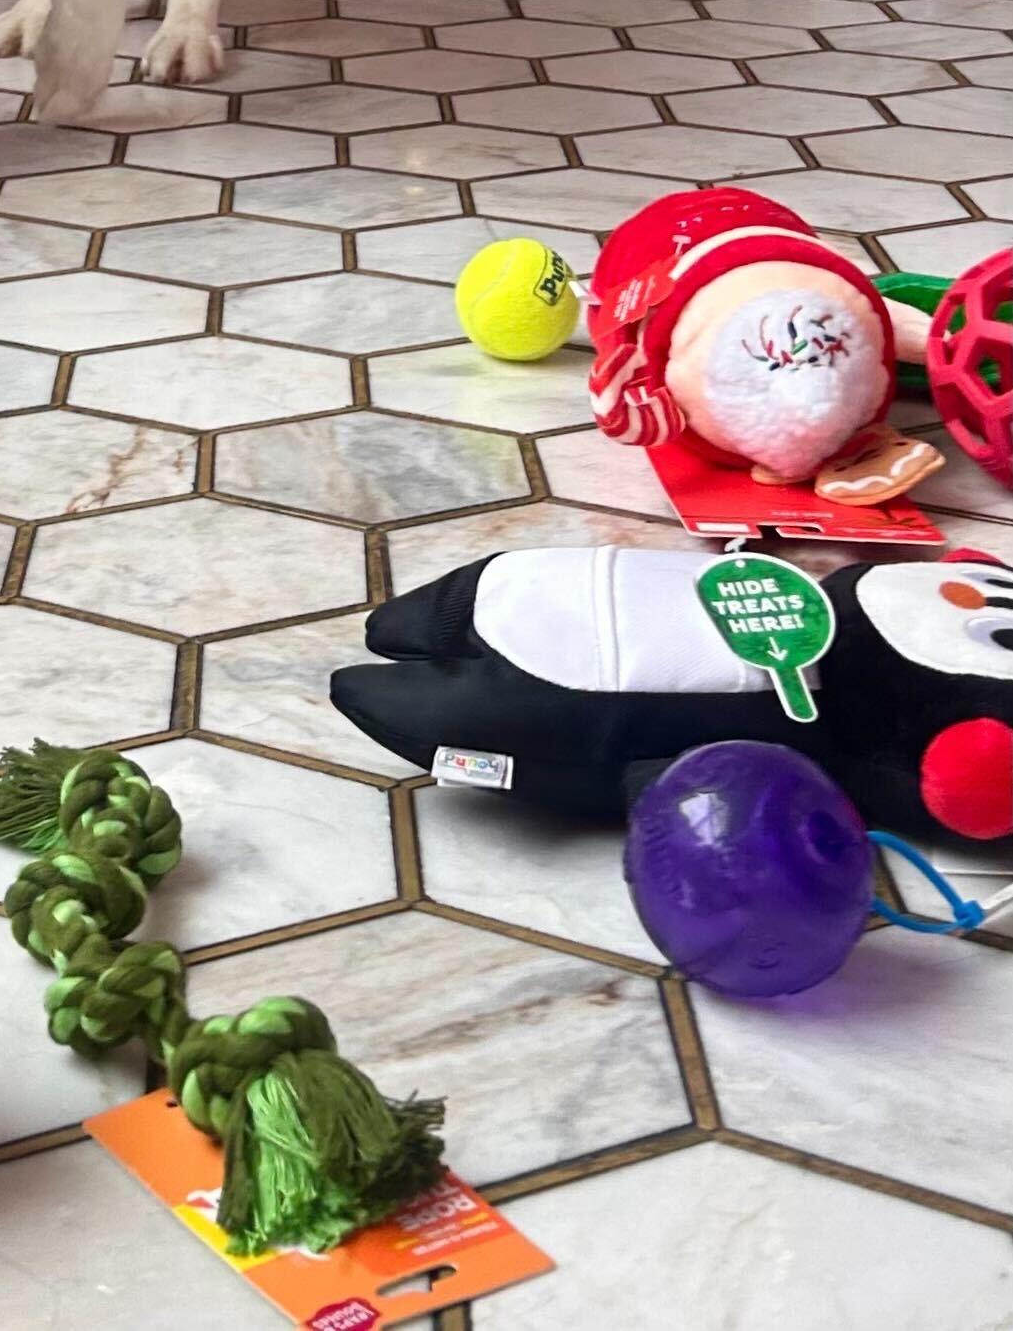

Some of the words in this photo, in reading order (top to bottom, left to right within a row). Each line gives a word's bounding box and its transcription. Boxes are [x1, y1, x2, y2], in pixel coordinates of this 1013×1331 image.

[717, 578, 780, 597] HIDE
[711, 594, 805, 615] TREATS
[728, 613, 805, 634] HERE!
